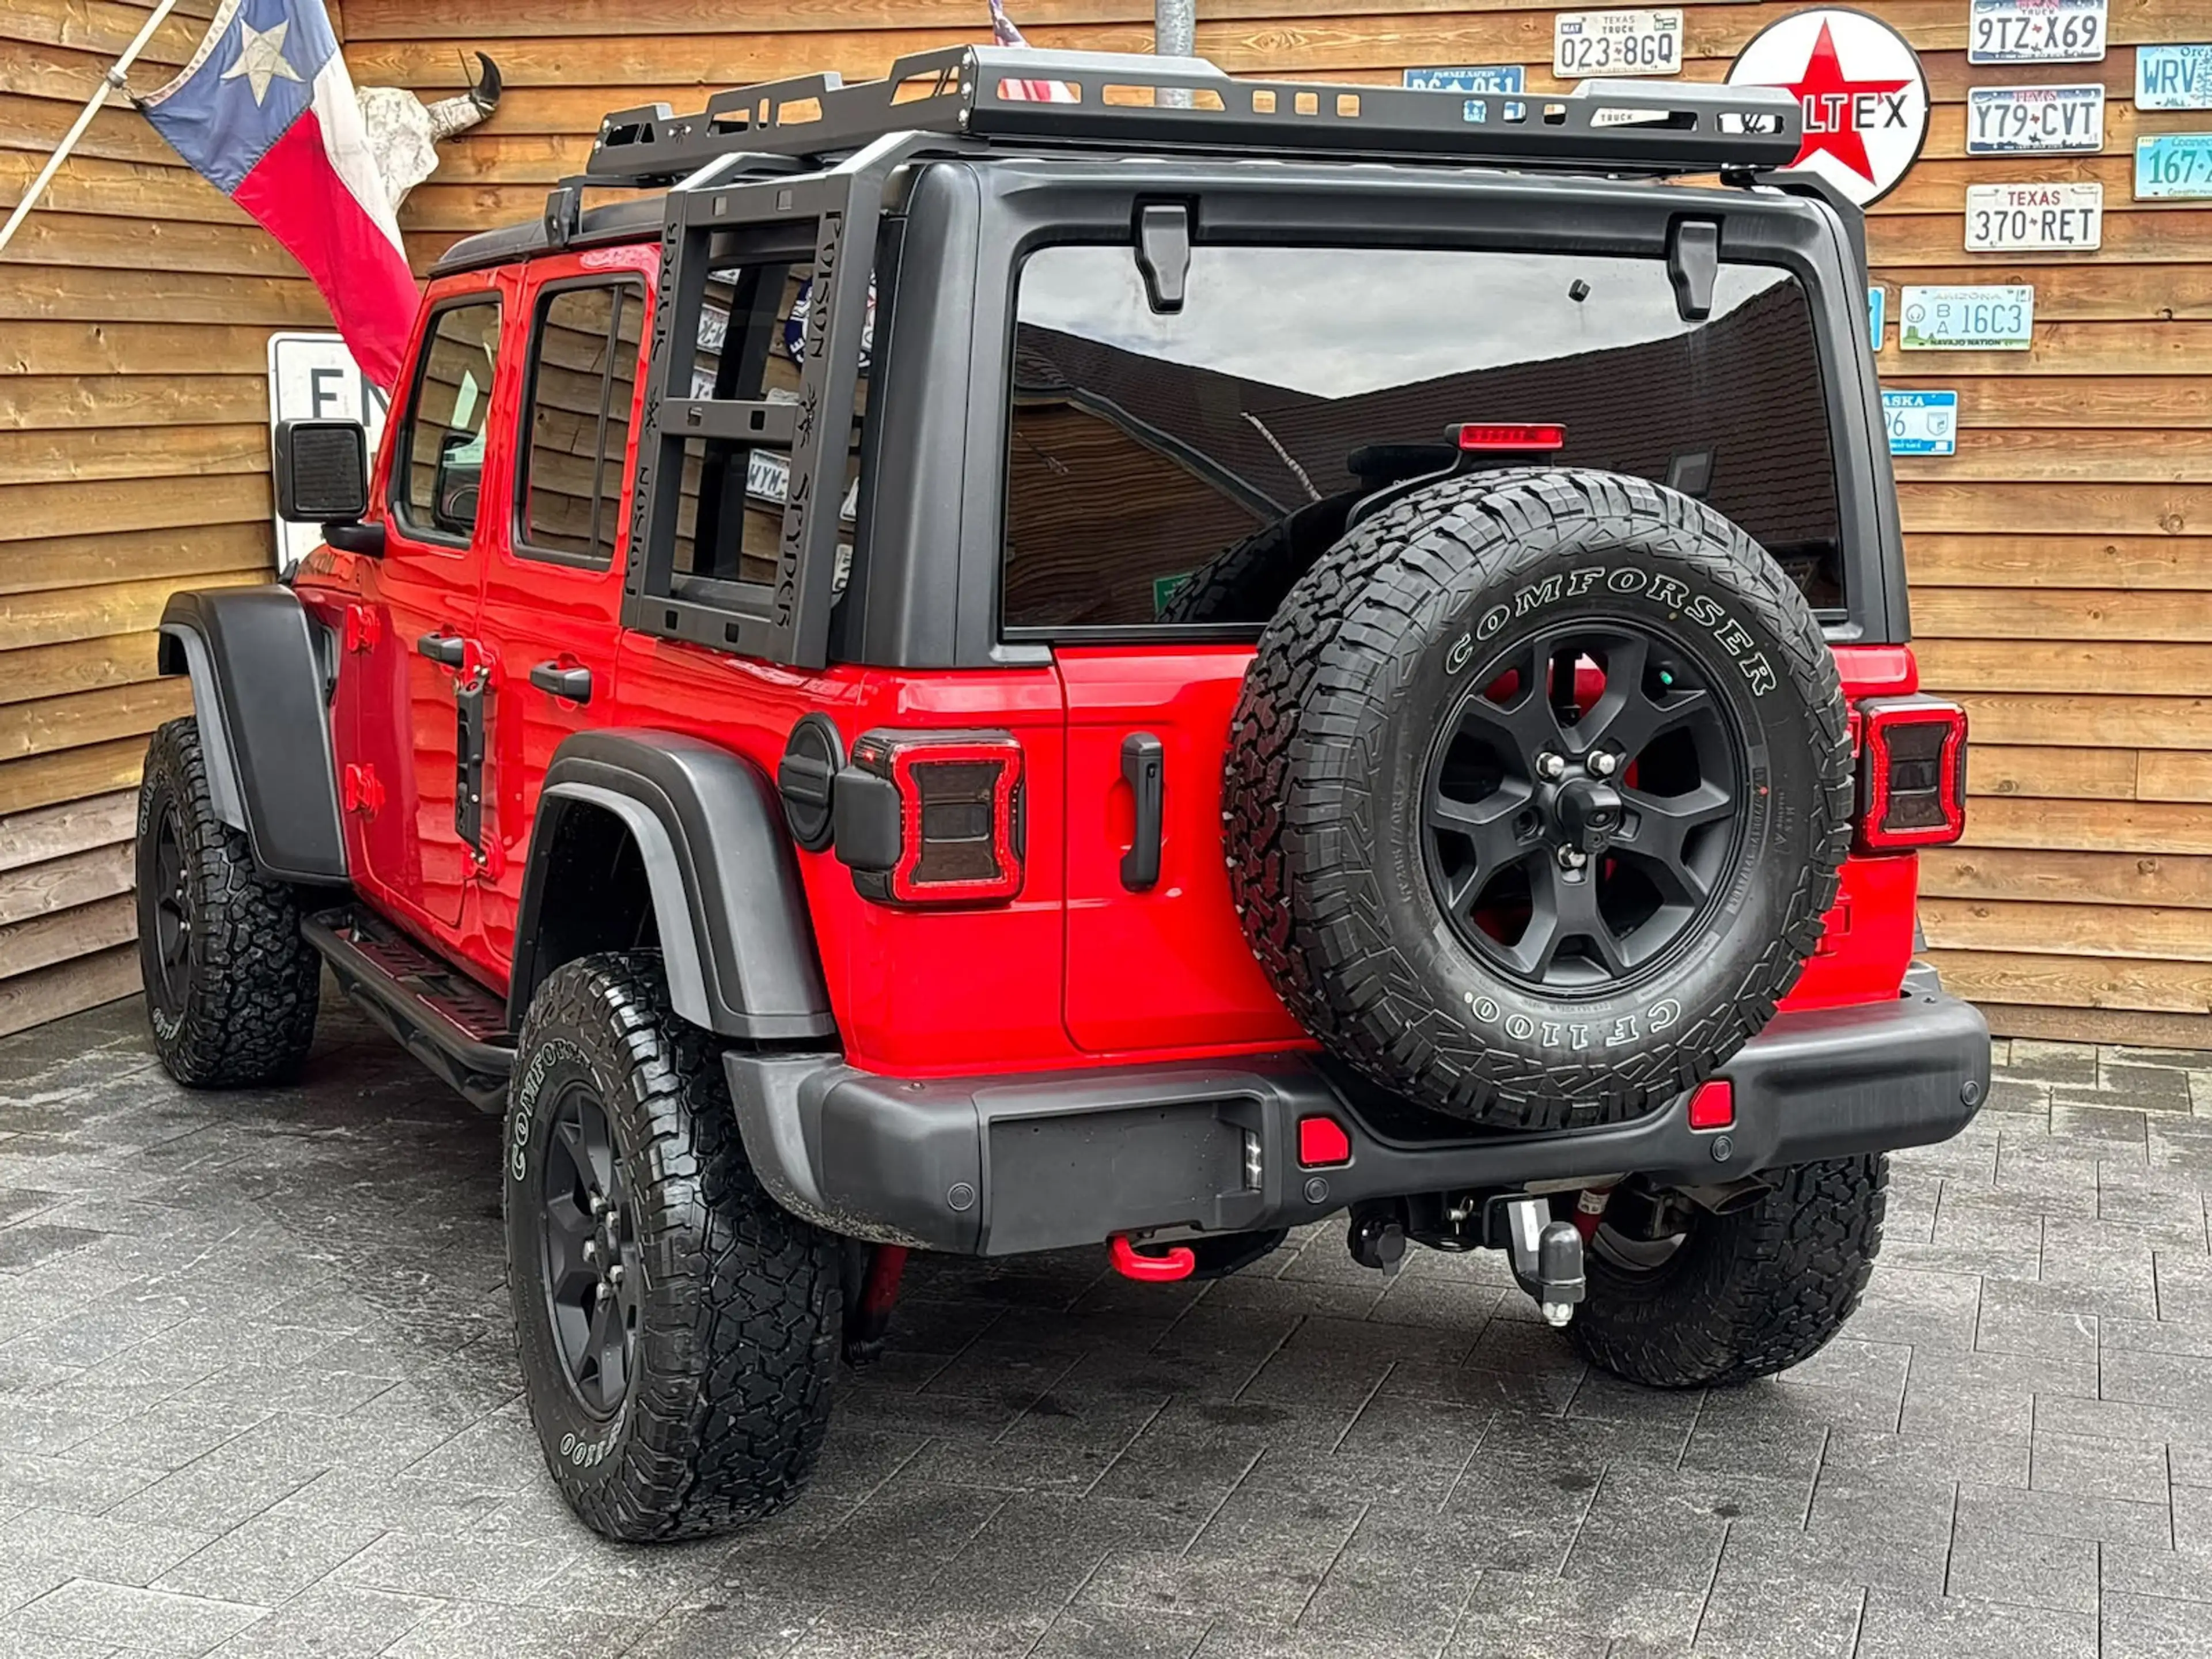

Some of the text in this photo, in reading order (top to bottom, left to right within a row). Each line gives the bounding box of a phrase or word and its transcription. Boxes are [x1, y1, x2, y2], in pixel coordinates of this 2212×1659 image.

[1602, 25, 1634, 33] TRUCK
[1604, 15, 1635, 24] TEXAS
[1978, 15, 2098, 50] 9TZ X69
[1562, 37, 1610, 68] 023
[2143, 58, 2197, 94] WRV
[2016, 91, 2057, 102] TEXAS
[1601, 113, 1633, 122] TRUCK
[1976, 102, 2096, 138] Y79 CVT
[2008, 191, 2061, 206] TEXAS
[1975, 209, 2094, 241] 370 RET
[1961, 304, 2022, 334] 16C3
[1446, 567, 1777, 697] COMFORSER
[512, 1038, 604, 1181] COMFORS
